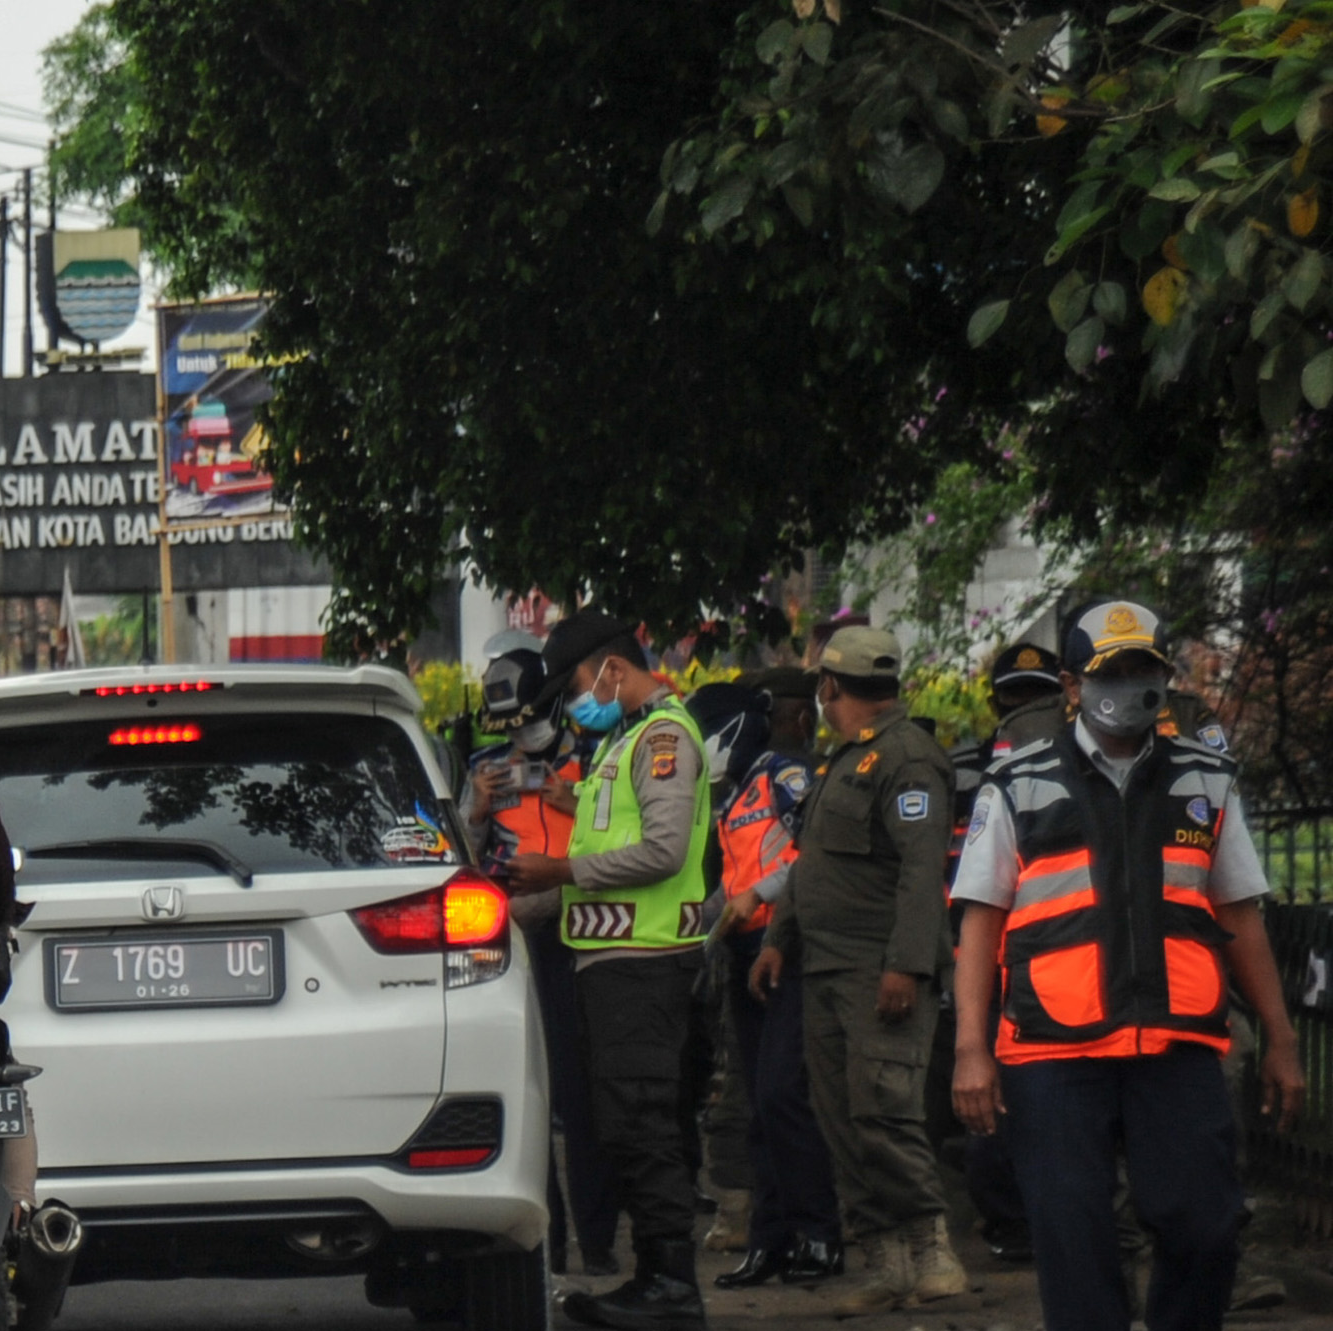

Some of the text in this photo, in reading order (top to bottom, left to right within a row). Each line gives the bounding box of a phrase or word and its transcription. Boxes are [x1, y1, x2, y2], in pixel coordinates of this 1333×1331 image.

[52, 471, 126, 506] ANDA
[130, 471, 161, 503] TE
[38, 515, 105, 547] KOTA
[61, 942, 266, 985] Z 1769 UC
